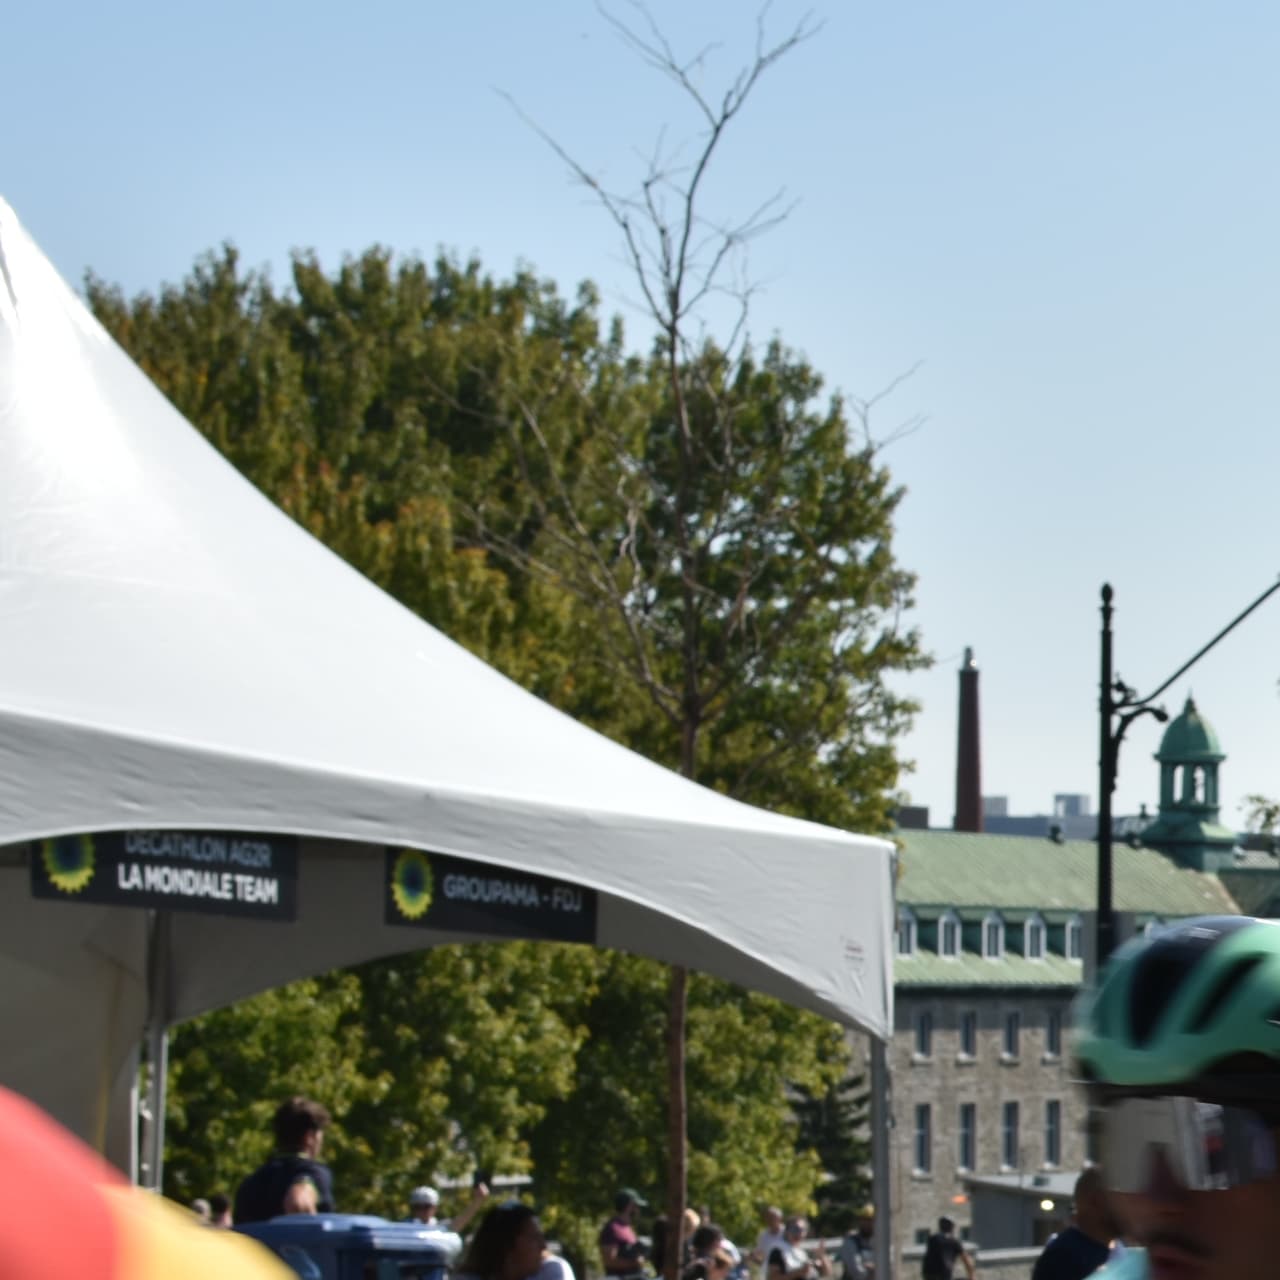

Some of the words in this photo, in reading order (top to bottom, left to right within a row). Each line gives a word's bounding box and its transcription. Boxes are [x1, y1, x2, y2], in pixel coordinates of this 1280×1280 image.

[124, 830, 227, 863] DECATHLON
[229, 842, 271, 868] AG2R
[117, 863, 143, 890] LA
[144, 865, 233, 900] MONDIALE
[234, 873, 279, 905] TEAM
[443, 873, 540, 908] GROUPAMA
[552, 887, 583, 913] FDJ
